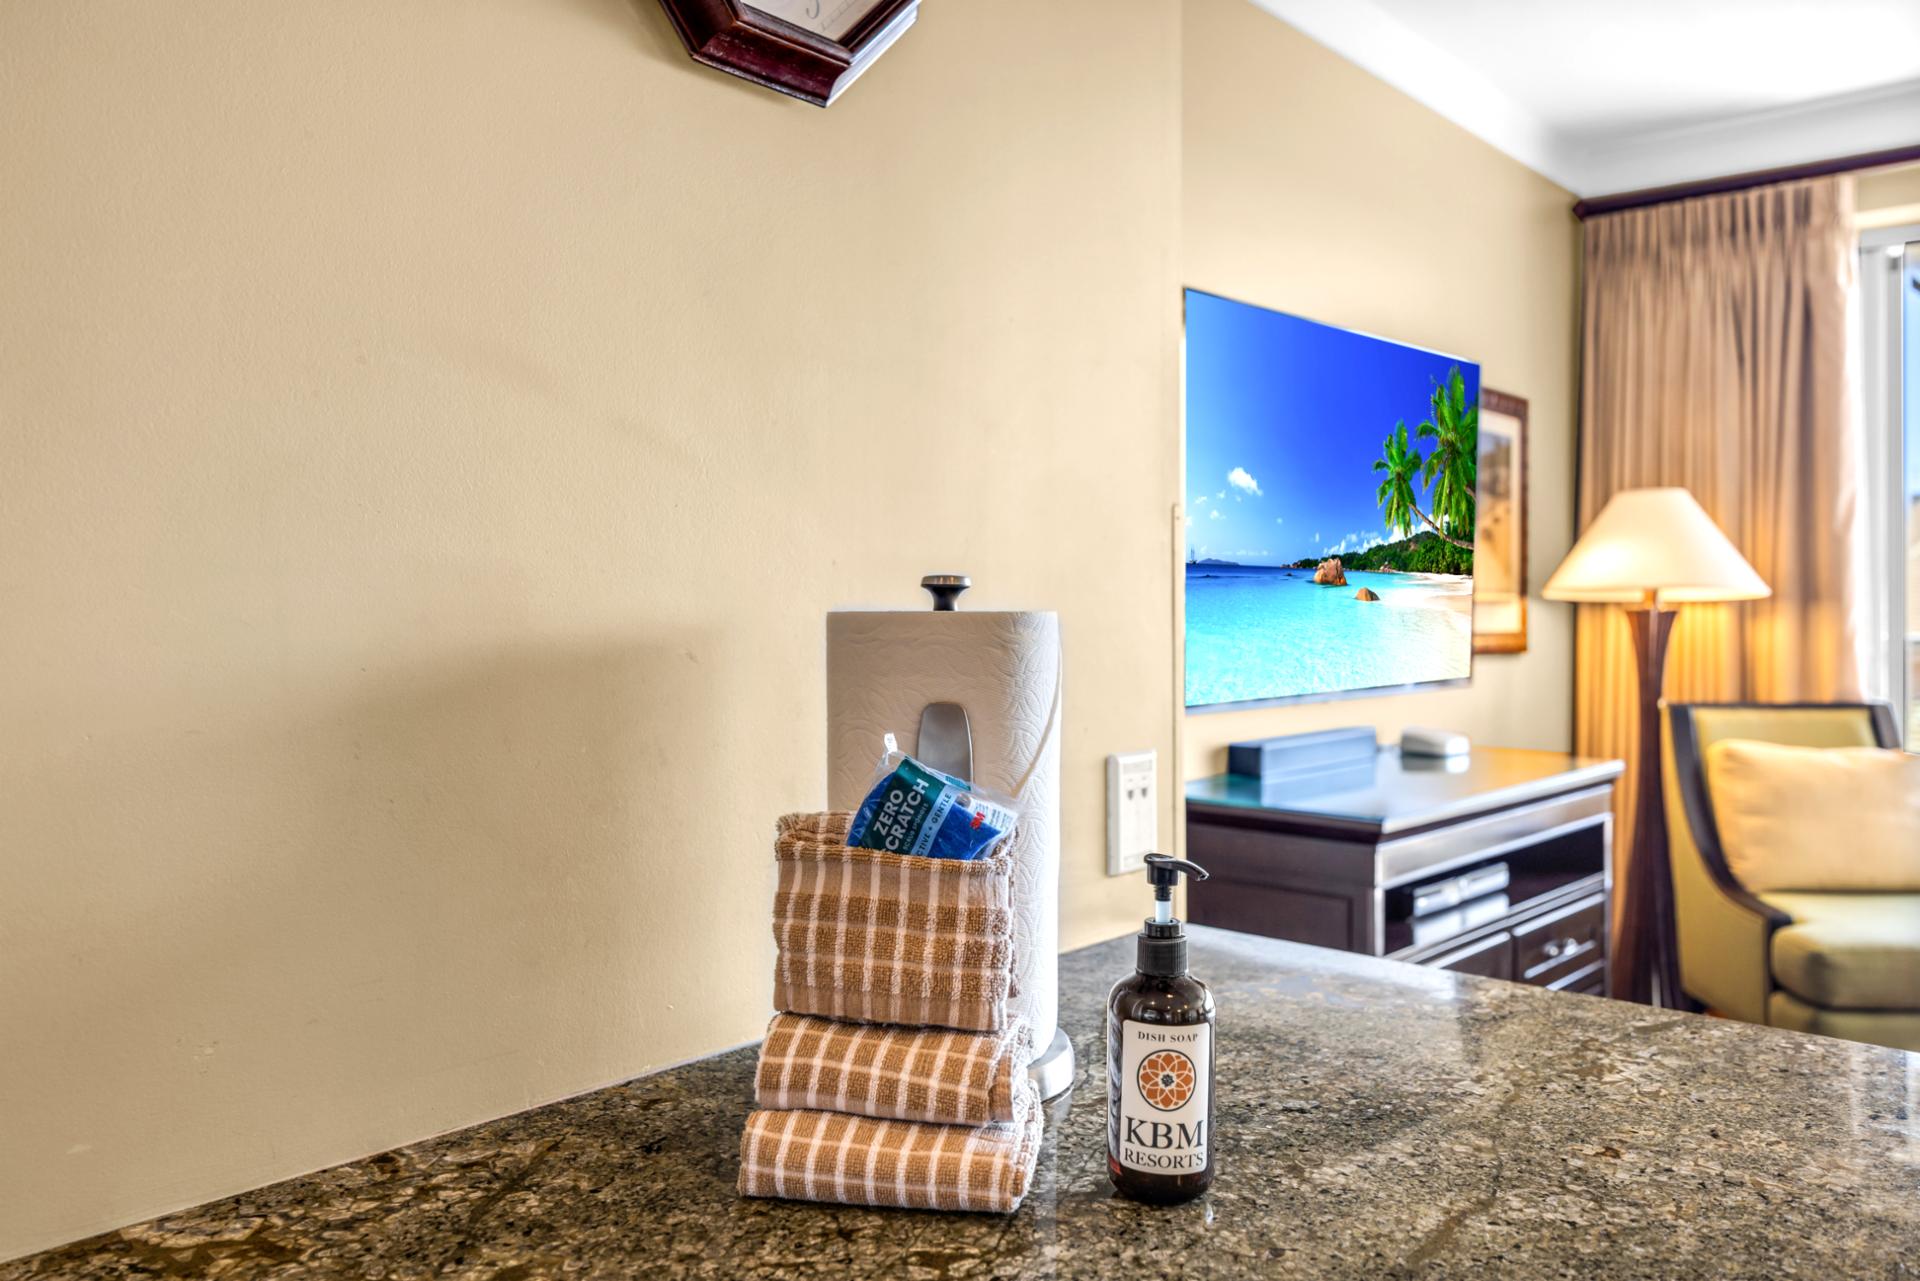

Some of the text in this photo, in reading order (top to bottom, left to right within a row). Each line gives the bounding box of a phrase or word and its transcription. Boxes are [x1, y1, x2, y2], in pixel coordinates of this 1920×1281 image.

[873, 789, 904, 836] ZERO
[881, 778, 930, 852] CRATCH
[916, 792, 952, 856] CTIVE GENTLE
[969, 811, 985, 830] 3M
[1137, 1031, 1199, 1043] DISH SOAP
[1125, 1115, 1204, 1150] KBM
[1124, 1147, 1204, 1169] RESORTS
